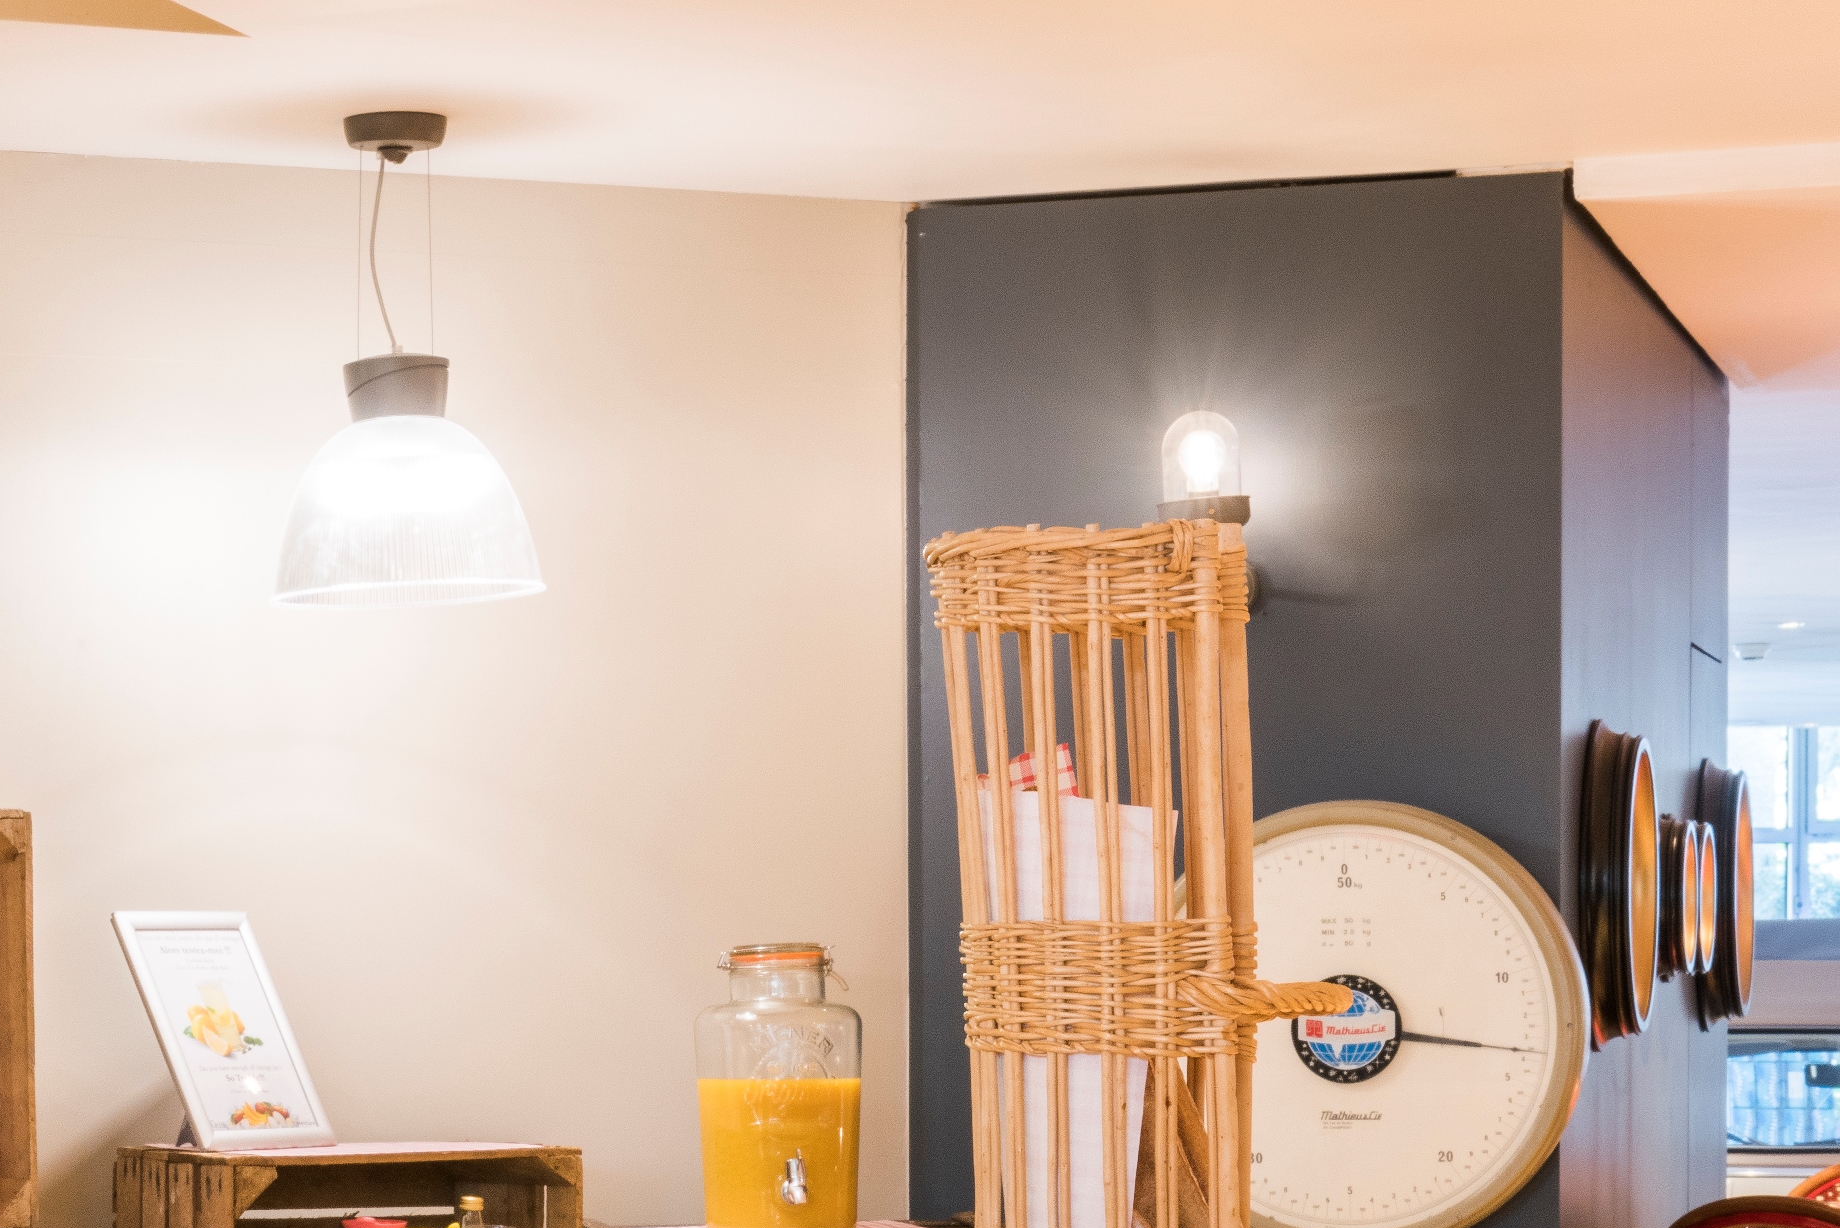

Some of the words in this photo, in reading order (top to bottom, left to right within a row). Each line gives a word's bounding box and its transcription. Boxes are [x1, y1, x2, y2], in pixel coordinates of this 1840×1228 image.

[1341, 864, 1348, 875] 0
[1338, 877, 1352, 888] 50
[1440, 892, 1446, 901] 5
[1495, 972, 1509, 983] 10
[1505, 1073, 1510, 1081] 5
[1438, 1151, 1454, 1162] 20
[1348, 1186, 1353, 1195] 5
